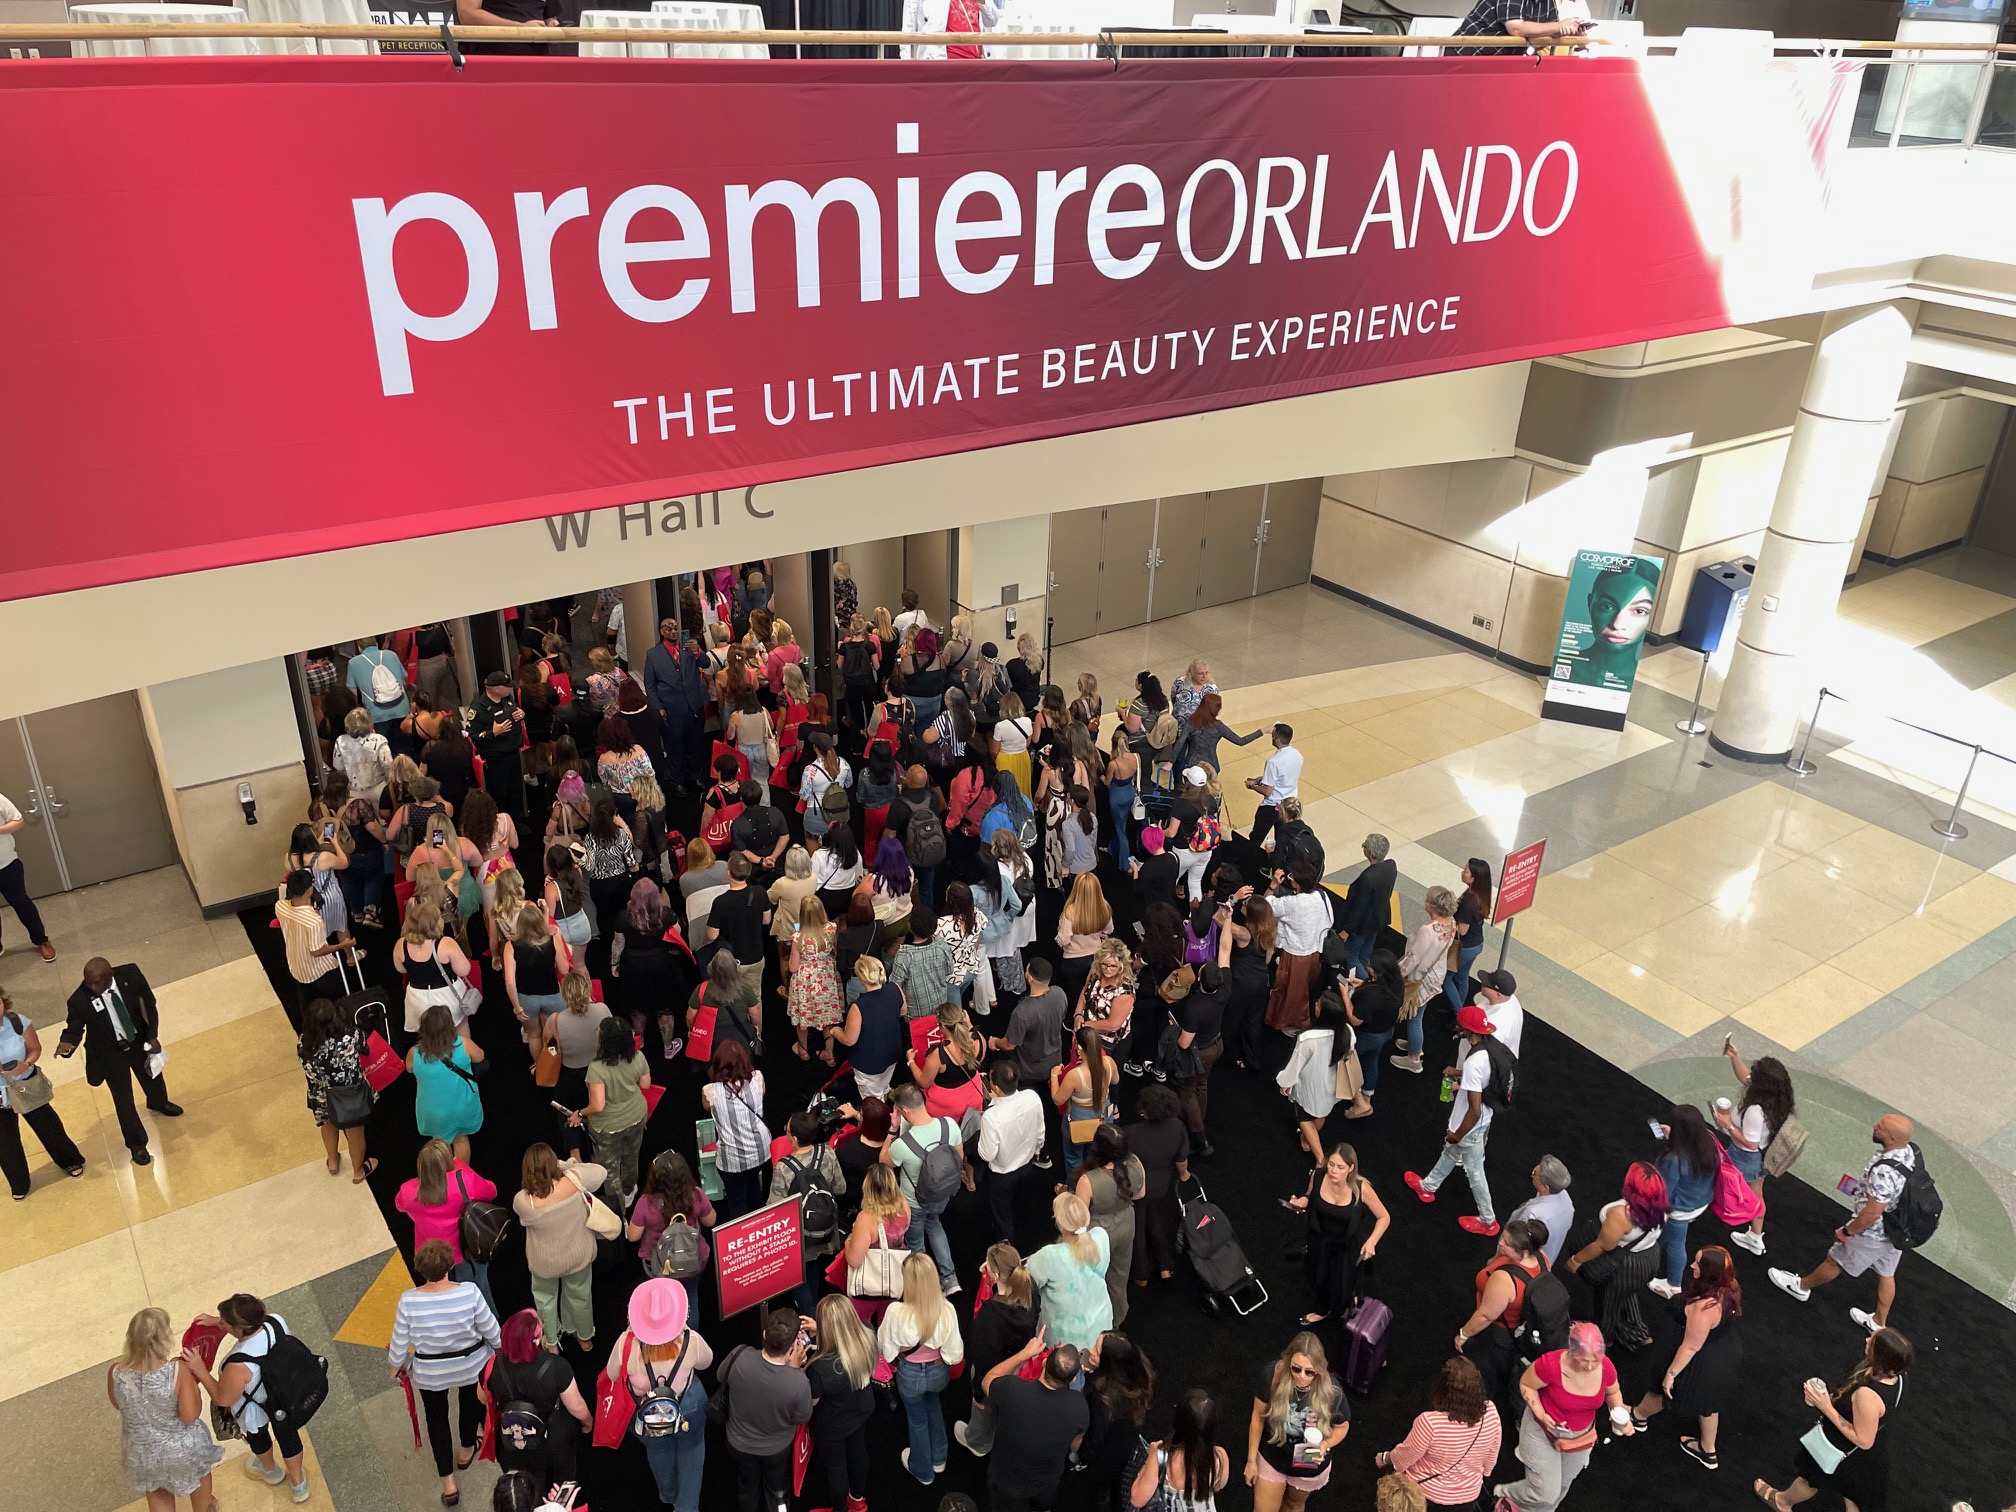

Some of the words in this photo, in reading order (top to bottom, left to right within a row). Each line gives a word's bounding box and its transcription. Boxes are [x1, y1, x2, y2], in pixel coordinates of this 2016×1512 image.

[397, 41, 445, 50] RECEPTION
[352, 123, 1165, 396] premiere
[1177, 141, 1578, 270] ORLANDO
[614, 388, 735, 444] THE
[764, 354, 1019, 425] ULTIMATE
[1043, 328, 1215, 388] BEAUTY
[1231, 296, 1460, 360] EXPERIENCE
[544, 510, 591, 552] W
[618, 491, 720, 541] Hall
[745, 486, 774, 518] C
[1581, 553, 1635, 566] COSMOPROF
[1508, 854, 1538, 874] RE-ENTRY
[722, 1254, 732, 1262] TO
[733, 1248, 747, 1259] THE
[747, 1237, 774, 1253] EXHIBIT
[774, 1227, 796, 1242] FLOOR
[728, 1217, 790, 1252] RE-ENTRY
[728, 1248, 762, 1266] WITHOUT
[769, 1236, 792, 1249] STAMP
[723, 1258, 757, 1276] REQUIRES
[764, 1245, 788, 1258] PHOTO
[789, 1240, 798, 1248] ID.
